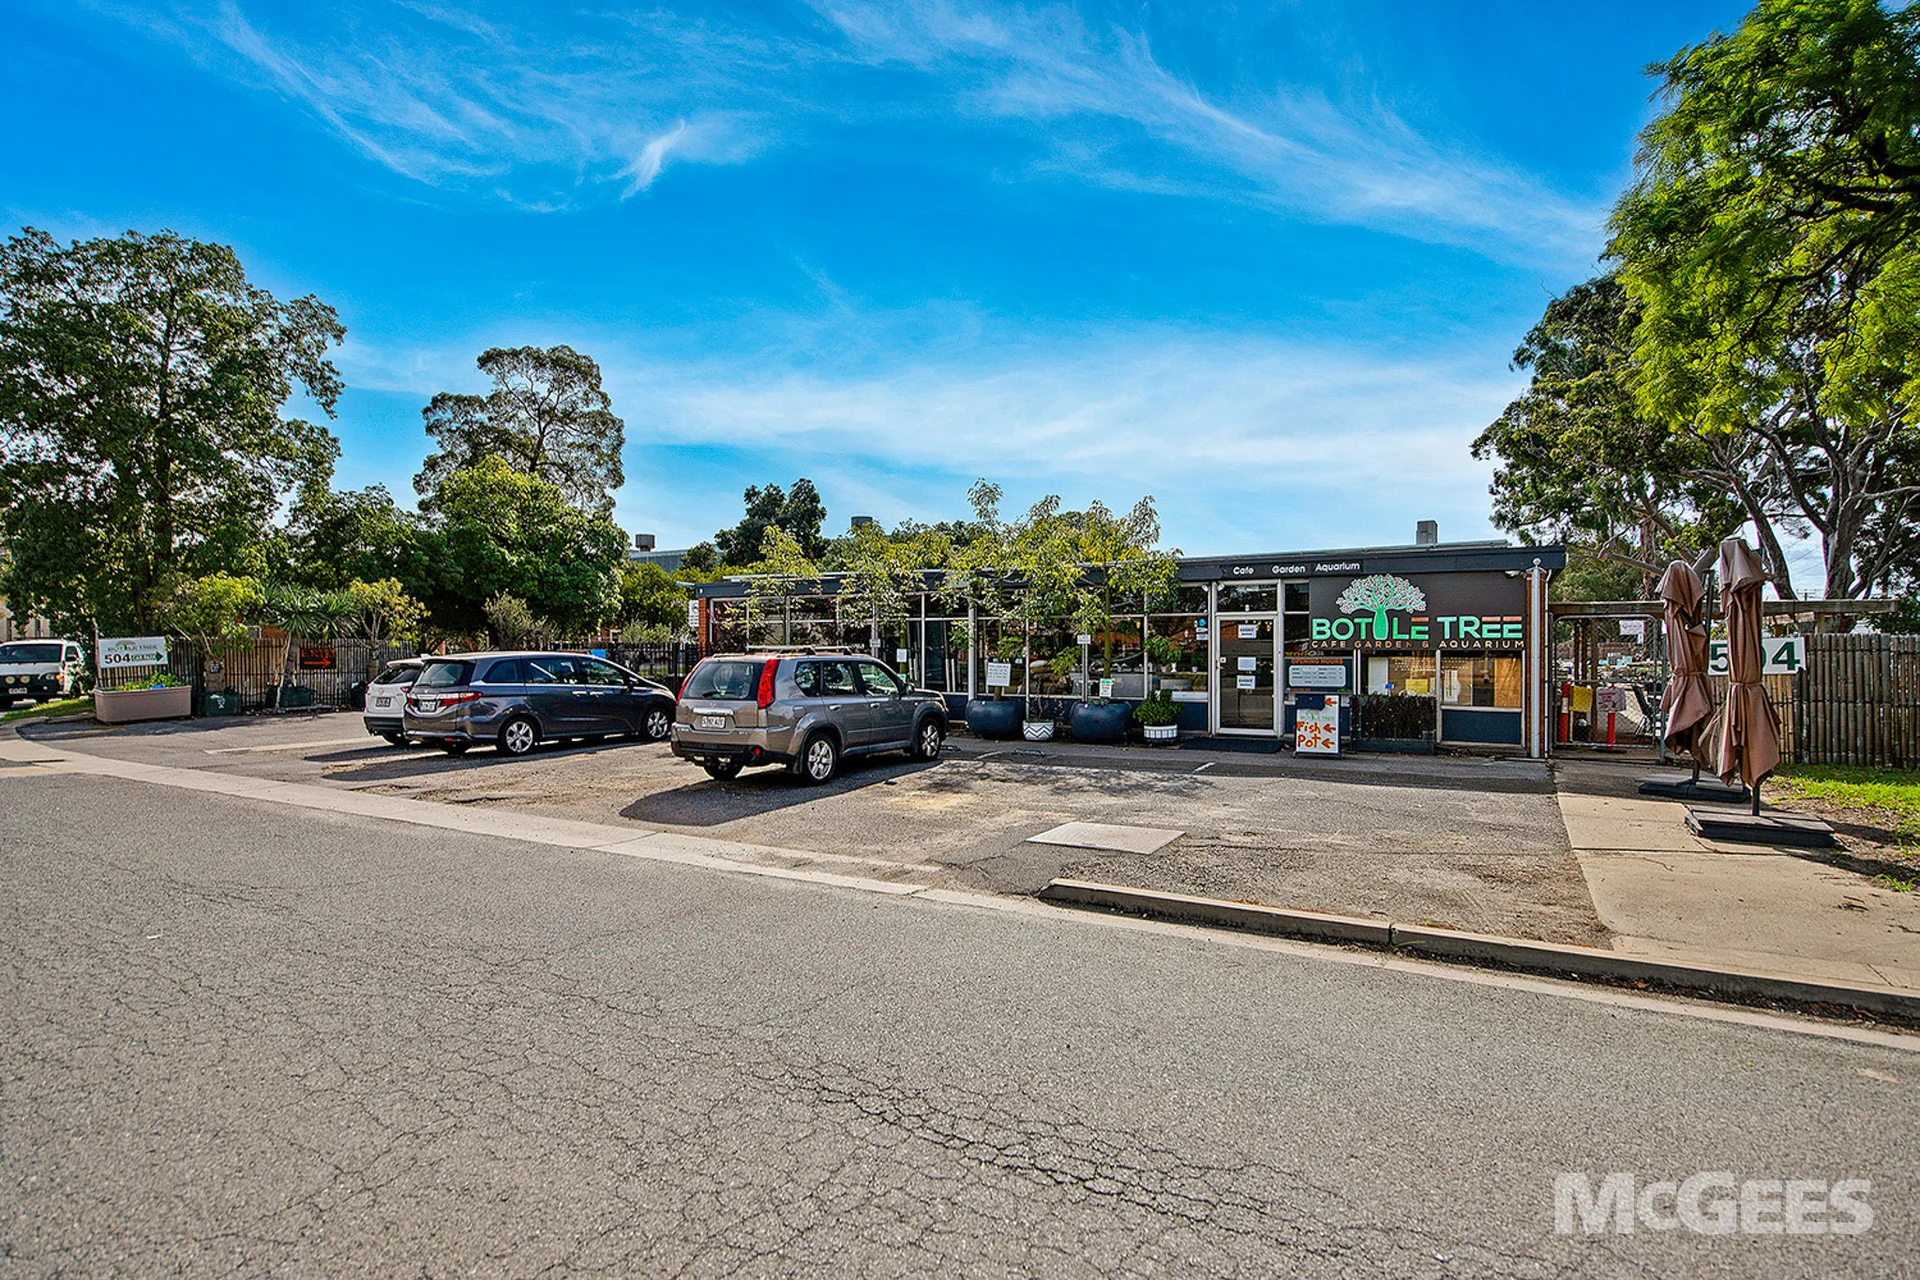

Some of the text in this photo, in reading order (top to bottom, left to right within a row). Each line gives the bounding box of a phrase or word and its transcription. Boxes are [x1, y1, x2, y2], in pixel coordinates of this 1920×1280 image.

[1232, 562, 1360, 575] Cafe Garden Aquarium
[1436, 616, 1522, 639] TREE
[1311, 641, 1347, 649] CAFE
[1422, 640, 1429, 648] &
[1438, 640, 1524, 648] AQUARIUM
[104, 653, 131, 664] 504
[1297, 721, 1321, 734] Fish
[1297, 733, 1321, 748] Pot
